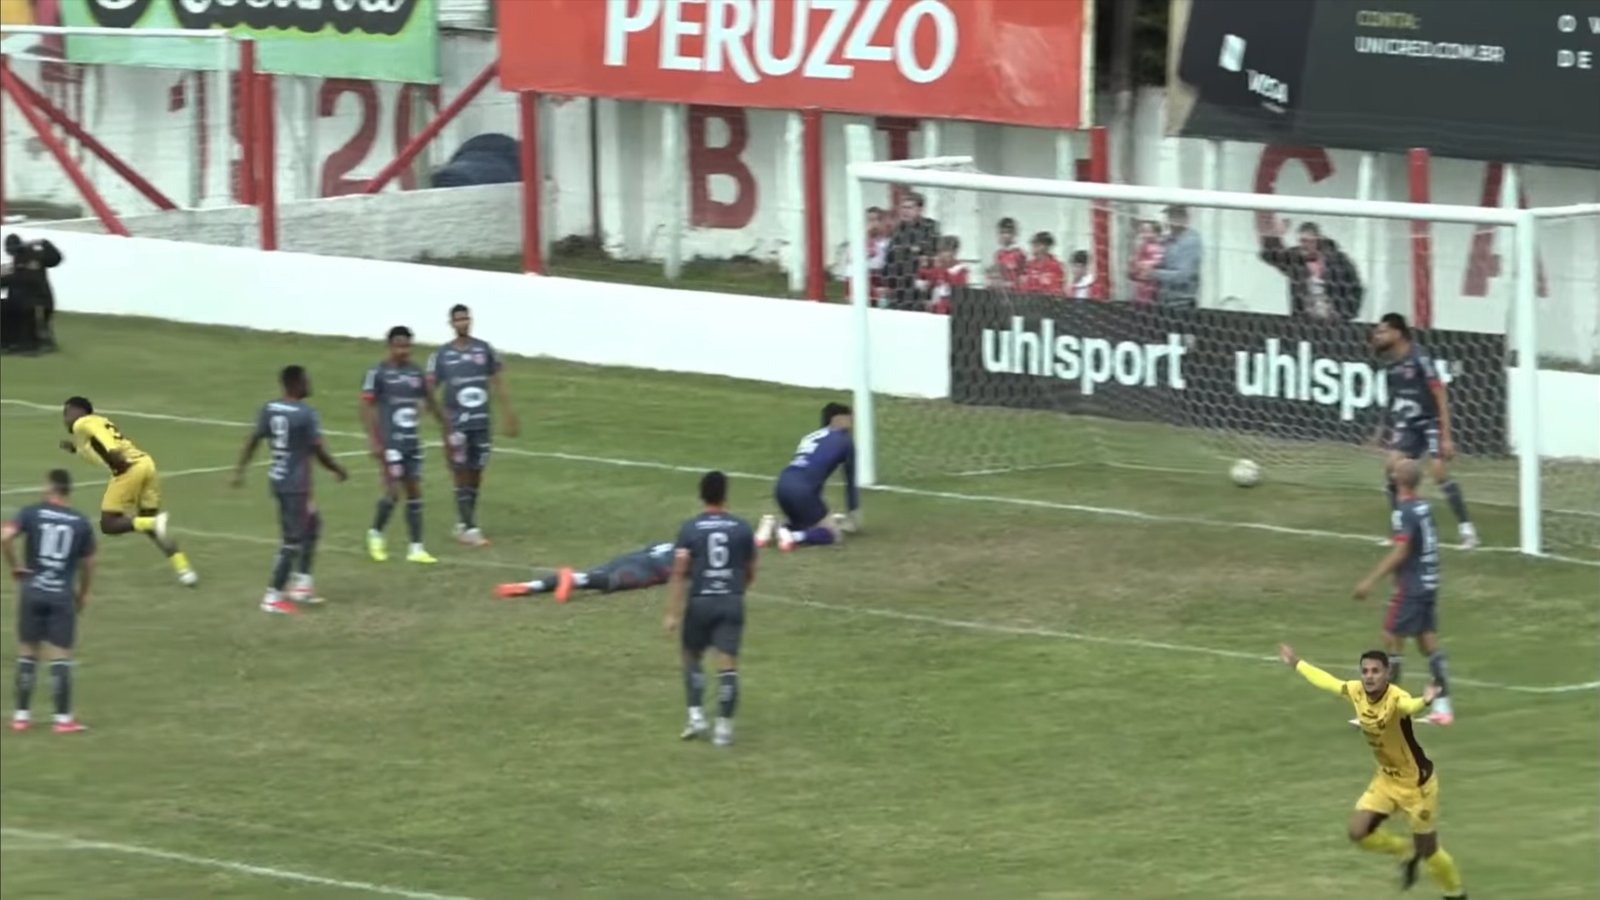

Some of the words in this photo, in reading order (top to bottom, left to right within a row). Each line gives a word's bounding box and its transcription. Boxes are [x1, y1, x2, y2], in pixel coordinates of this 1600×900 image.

[603, 0, 958, 83] PERUZZO
[1557, 49, 1594, 69] DE
[981, 315, 1188, 395] uhlsport
[1235, 338, 1453, 421] uhlsp
[269, 414, 289, 449] 9
[39, 522, 74, 559] 10
[707, 531, 730, 568] 6
